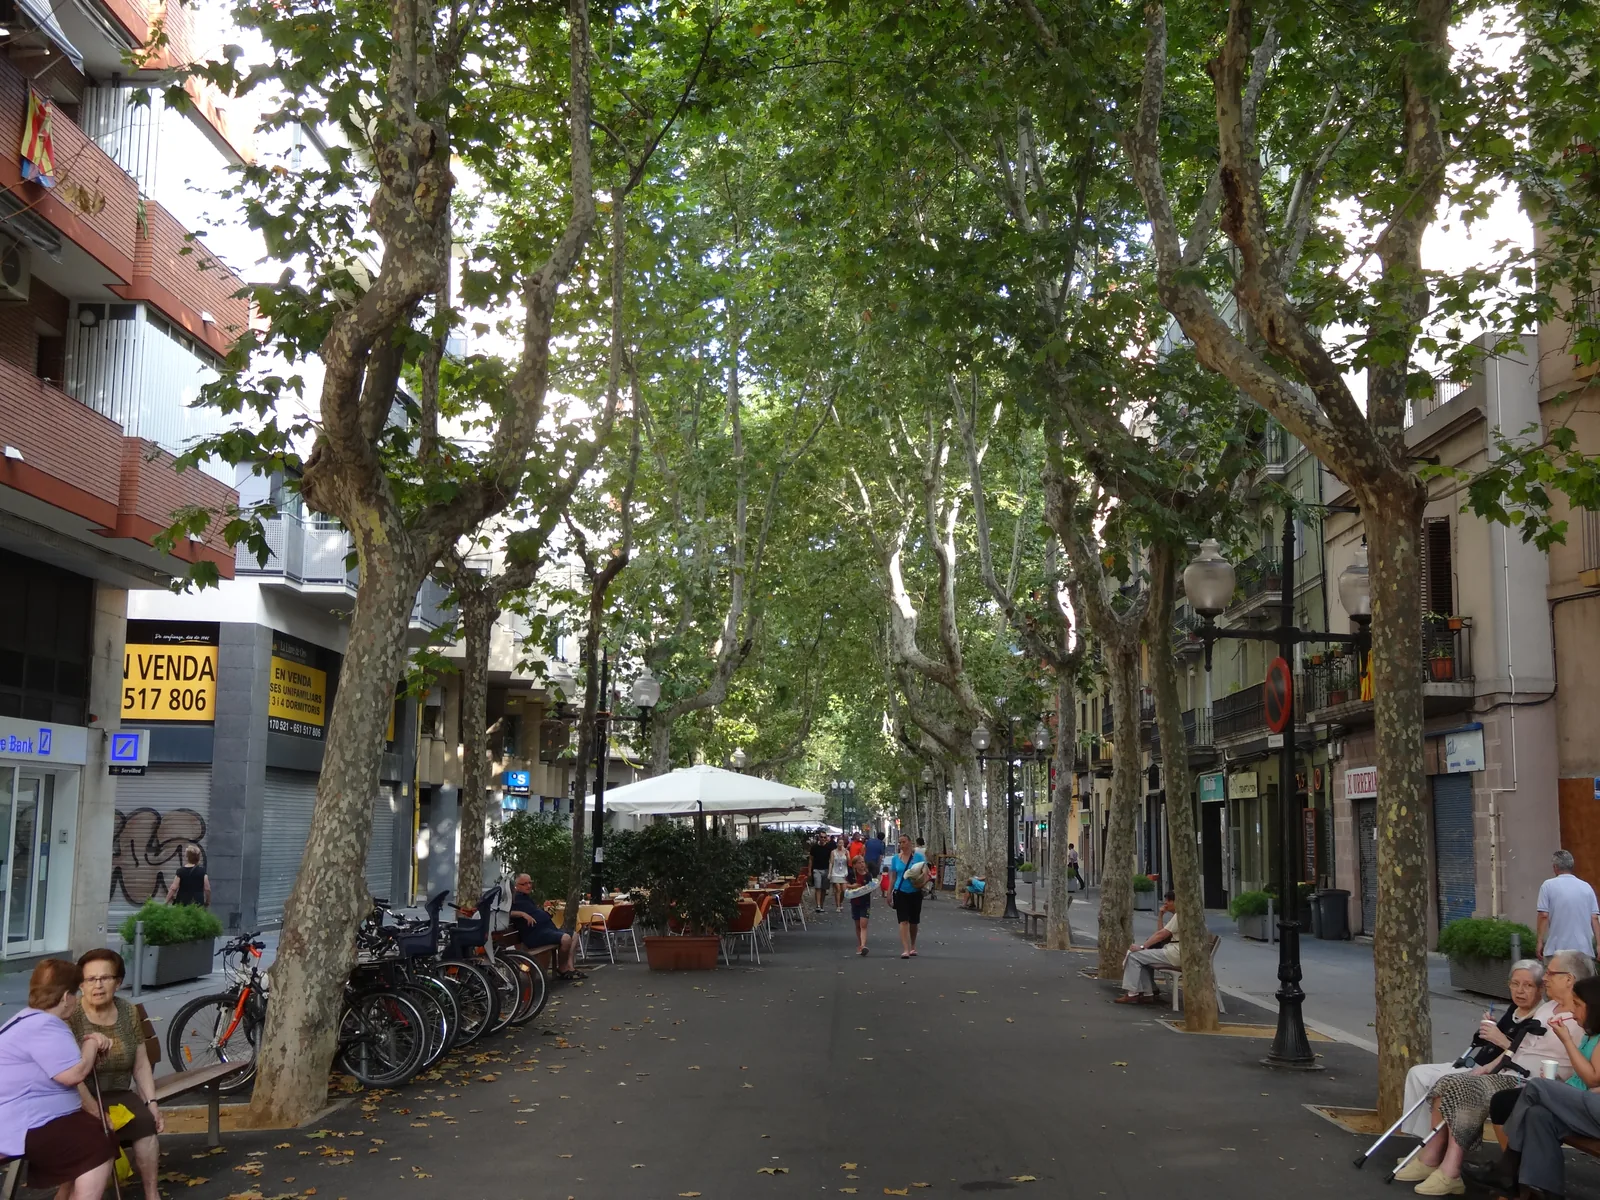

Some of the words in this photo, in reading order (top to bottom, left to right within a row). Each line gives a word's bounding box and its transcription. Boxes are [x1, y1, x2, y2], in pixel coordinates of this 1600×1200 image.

[137, 653, 215, 682] VENDA
[275, 667, 286, 681] EN
[287, 670, 312, 688] VENDA
[123, 687, 162, 710] 517
[169, 688, 206, 711] 806
[283, 686, 322, 704] UNIFAMILIARS
[272, 696, 276, 706] 3
[280, 698, 284, 707] 4
[285, 699, 320, 716] DORMITORIS
[279, 720, 289, 731] 521
[293, 723, 302, 734] 651
[9, 735, 33, 754] Bank
